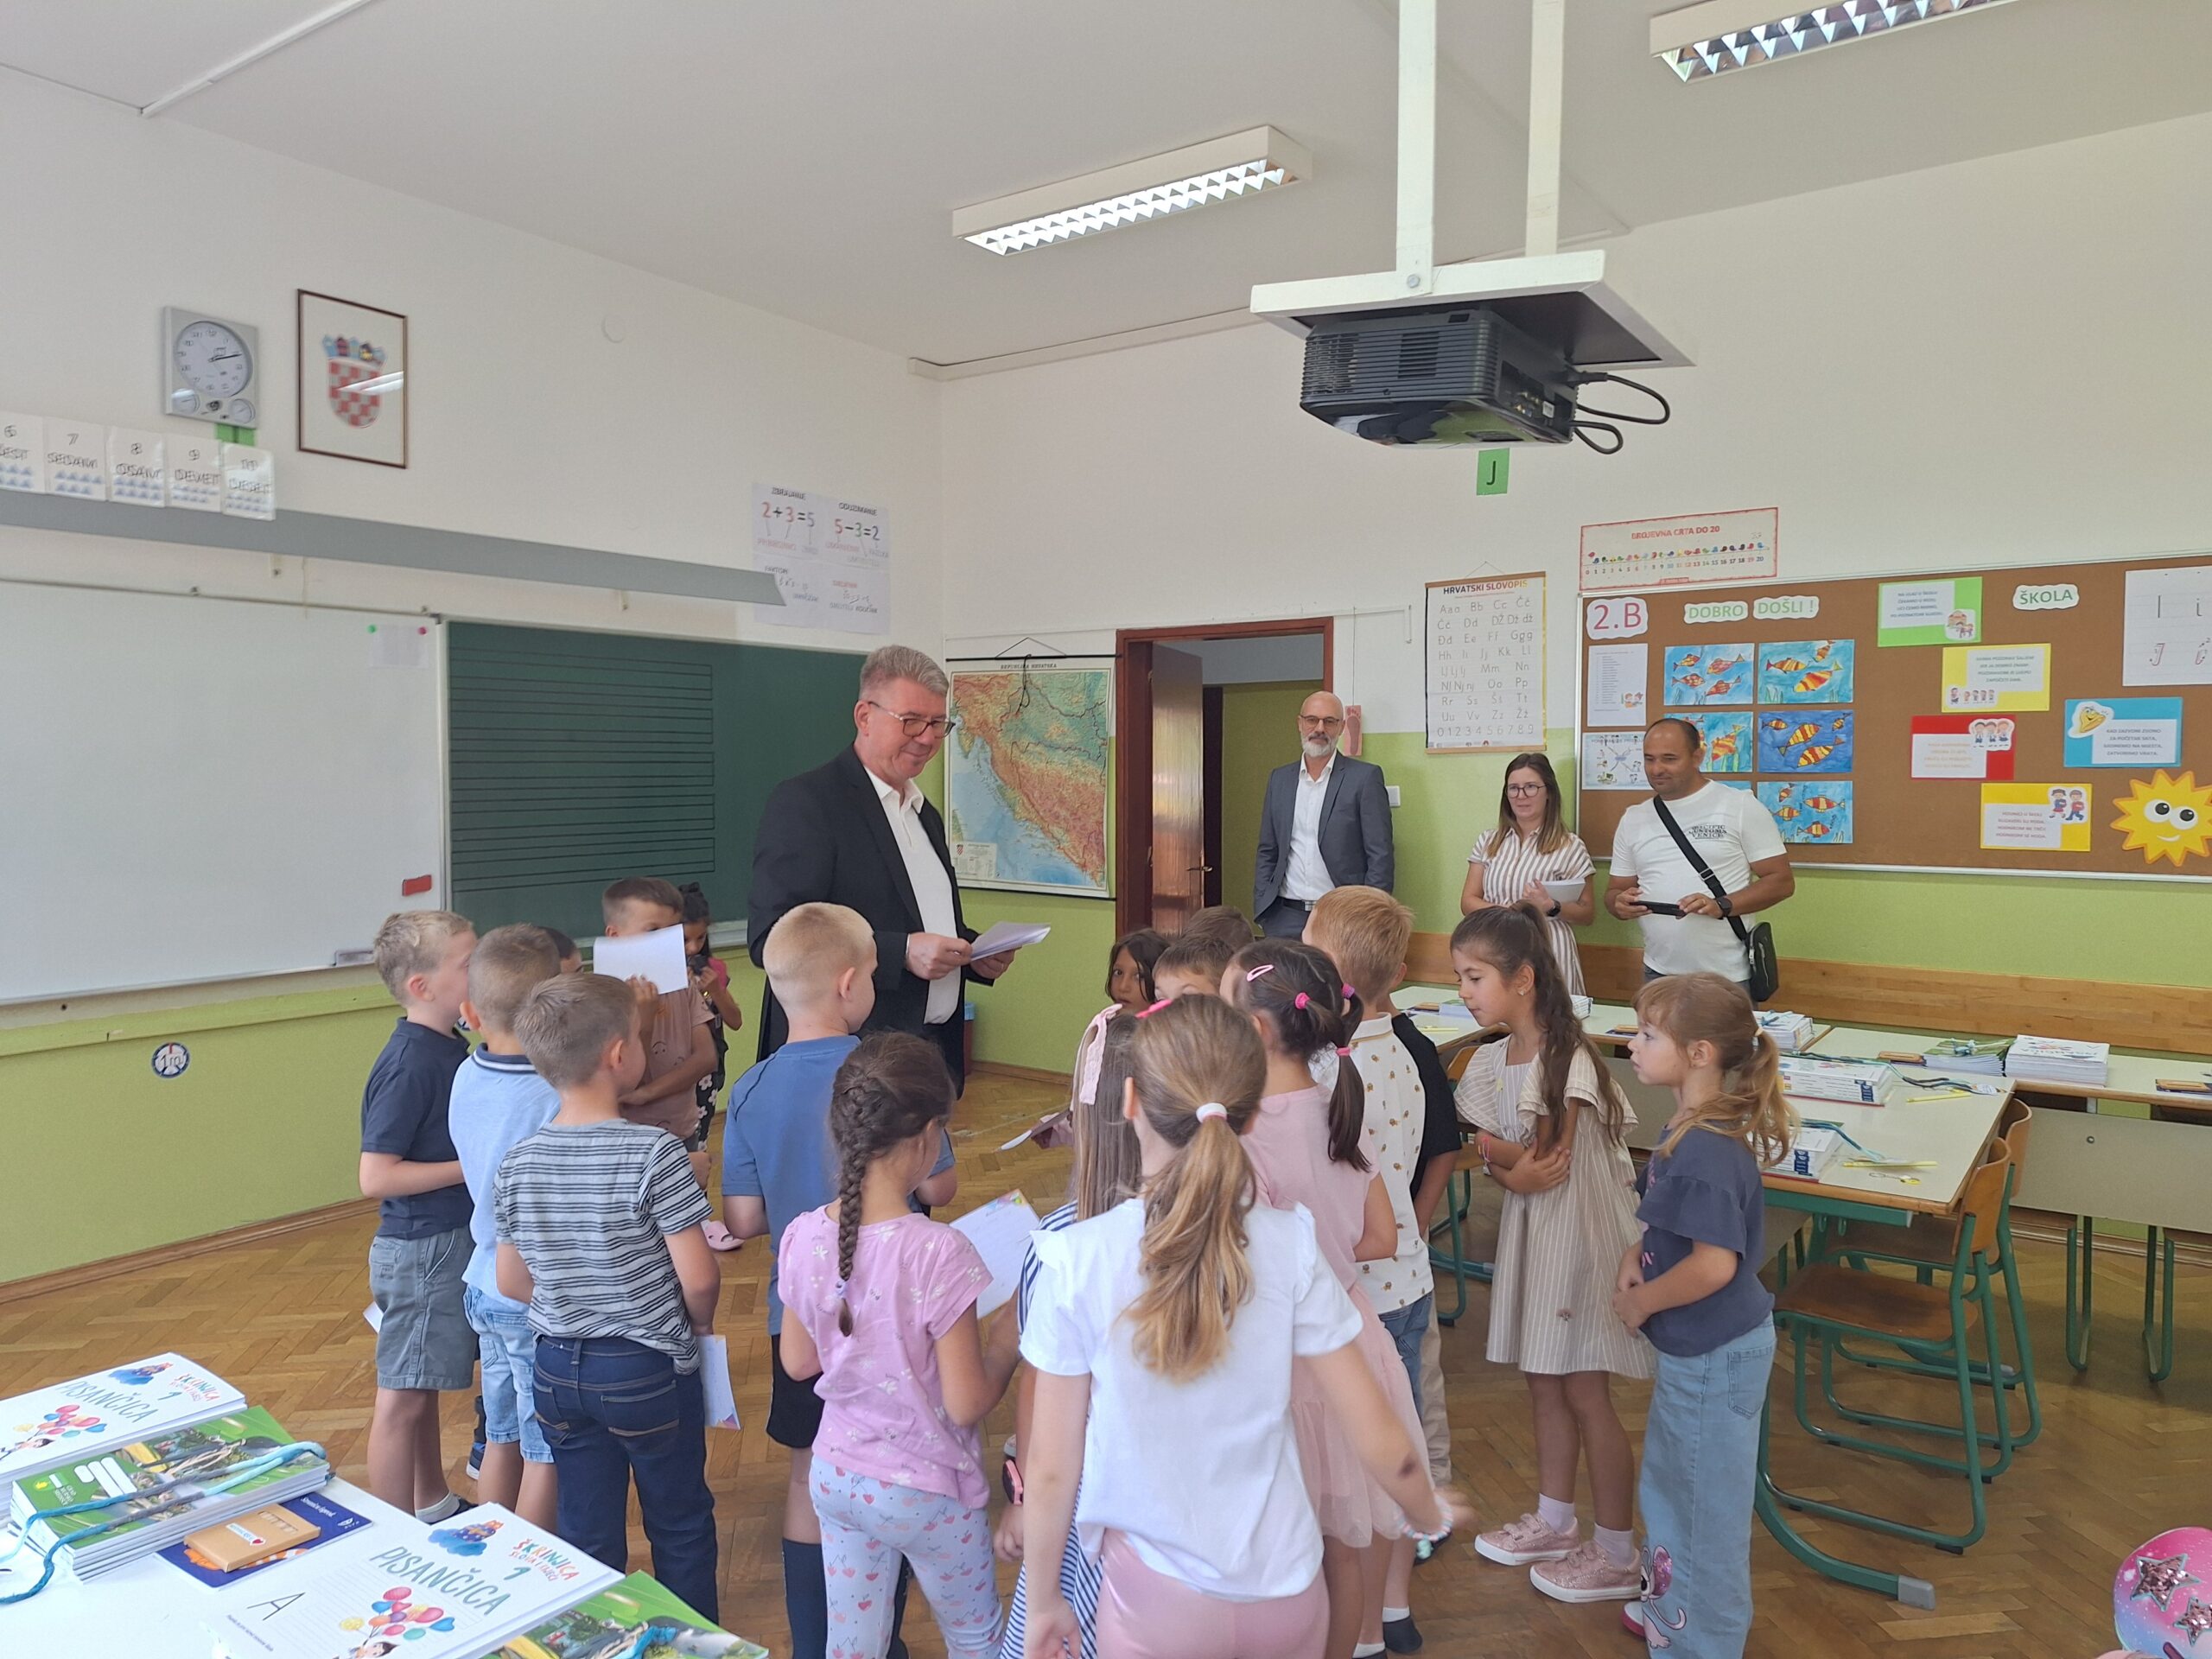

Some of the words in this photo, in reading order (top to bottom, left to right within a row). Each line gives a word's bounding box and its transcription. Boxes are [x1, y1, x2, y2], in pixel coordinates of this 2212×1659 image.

[67, 433, 79, 445] 7
[130, 442, 143, 455] 8
[188, 448, 200, 461] 9
[1486, 461, 1497, 486] J
[1631, 530, 1672, 540] BROJEVNA
[1674, 527, 1694, 537] CRTA
[1443, 583, 1484, 595] HRVATSKI
[1486, 580, 1529, 592] SLOVOPIS
[2020, 588, 2074, 606] ŠKOLA
[1593, 602, 1642, 631] 2.B
[1688, 604, 1745, 620] DOBRO
[1758, 599, 1803, 615] DOŠLI
[1808, 600, 1814, 613] !
[1437, 728, 1445, 738] 0
[1447, 728, 1452, 737] 1
[1455, 727, 1462, 737] 2
[1465, 726, 1471, 736] 3
[1475, 726, 1482, 736] 4
[1486, 726, 1493, 735] 5
[1497, 725, 1503, 735] 6
[1508, 724, 1514, 735] 7
[1517, 724, 1524, 734] 8
[1528, 724, 1535, 734] 9
[55, 1380, 159, 1423] PISANČICA
[512, 1538, 581, 1580] ŠKRINJICA
[369, 1546, 512, 1617] PISANČICA
[503, 1565, 532, 1581] 1
[246, 1592, 306, 1621] A
